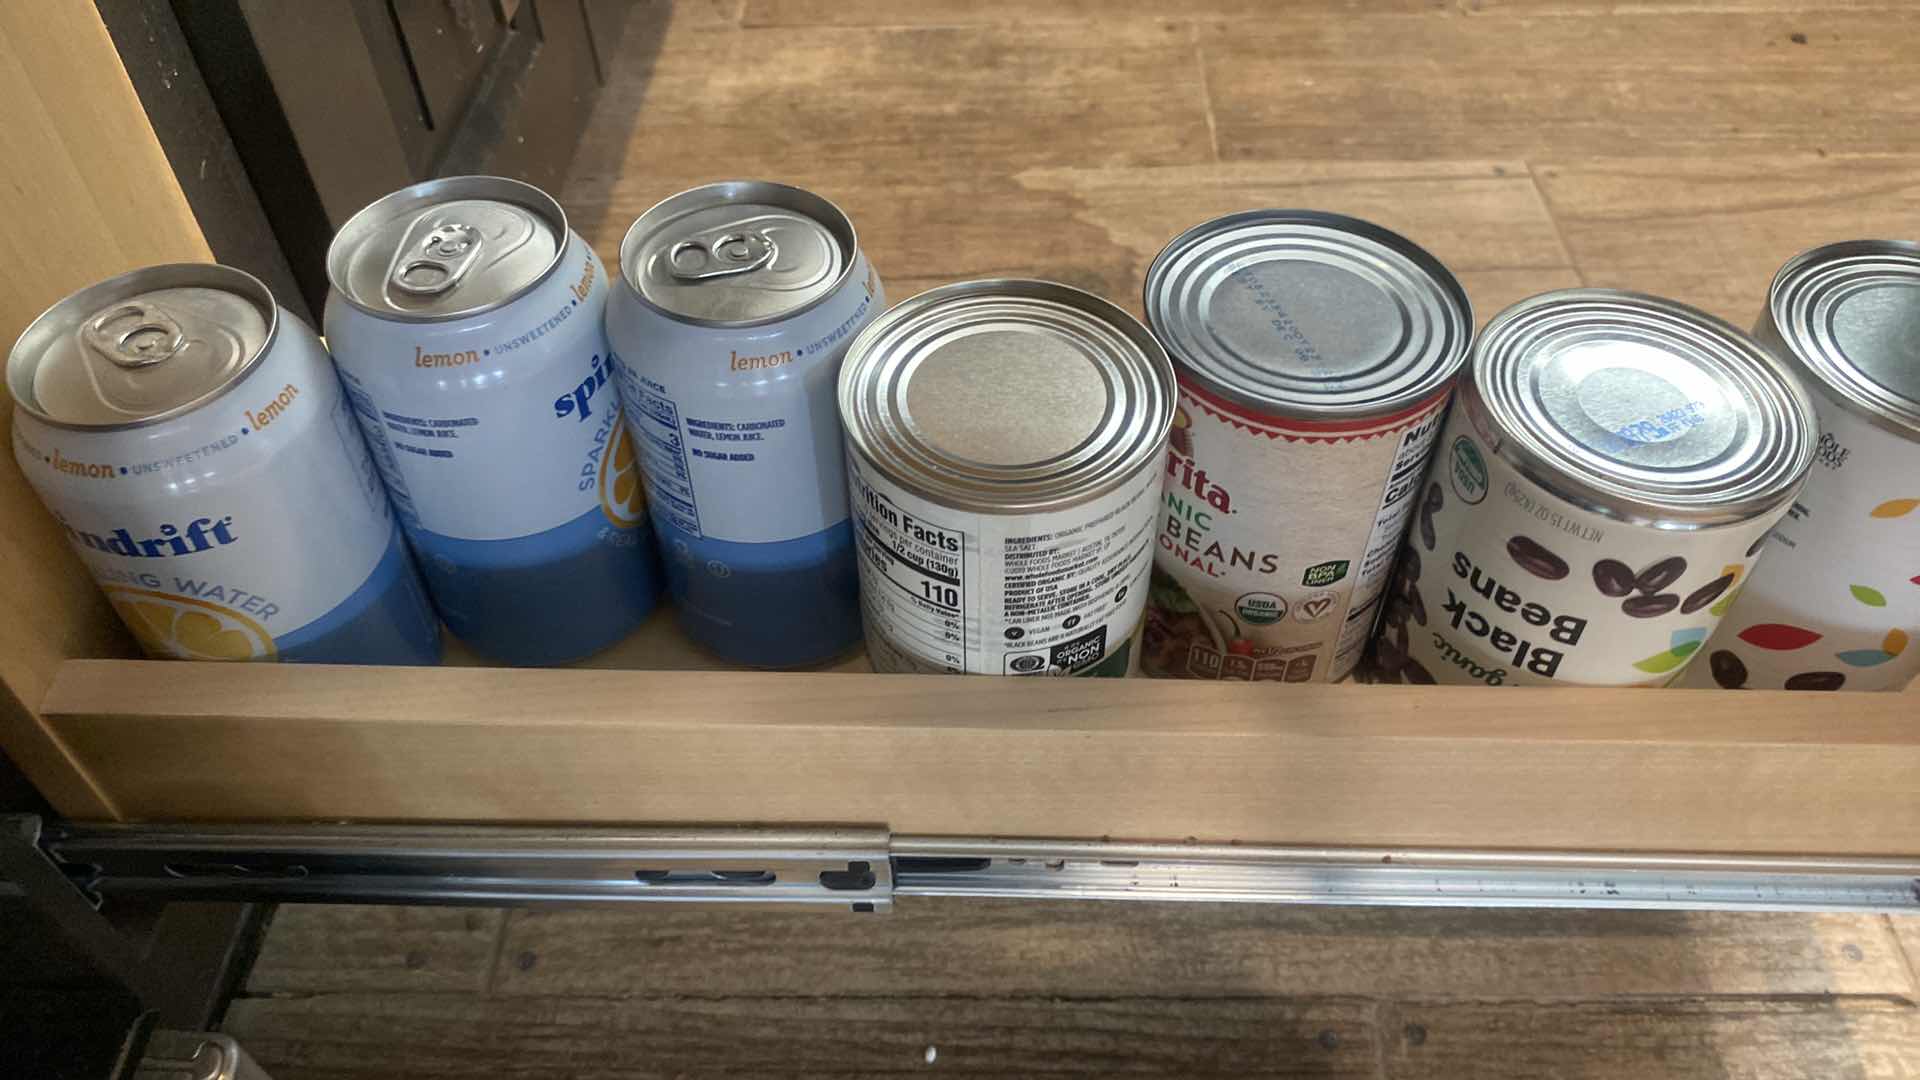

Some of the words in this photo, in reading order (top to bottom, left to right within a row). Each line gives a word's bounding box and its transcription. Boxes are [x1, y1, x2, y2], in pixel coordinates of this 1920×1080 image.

[415, 346, 481, 369] lemon
[493, 304, 573, 355] UNSWEETENED
[730, 350, 793, 372] lemon
[53, 448, 115, 478] lemon
[131, 434, 239, 476] UNSWEETENED
[244, 383, 298, 431] lemon
[1167, 450, 1231, 514] rita
[1166, 490, 1212, 532] NIC
[70, 516, 238, 558] ndrift
[903, 514, 959, 552] Facts
[1166, 515, 1279, 574] BEANS
[906, 549, 924, 565] cup
[1159, 533, 1219, 578] ONAL
[1308, 571, 1336, 580] BPA
[1309, 564, 1337, 573] NON
[173, 577, 280, 621] WATER
[921, 581, 958, 607] 110
[1248, 599, 1276, 609] USDA
[1452, 552, 1587, 646] Beans
[1056, 635, 1101, 659] ORGANIC
[1441, 586, 1565, 678] Black
[1068, 642, 1101, 665] NON
[1432, 632, 1507, 686] ganic
